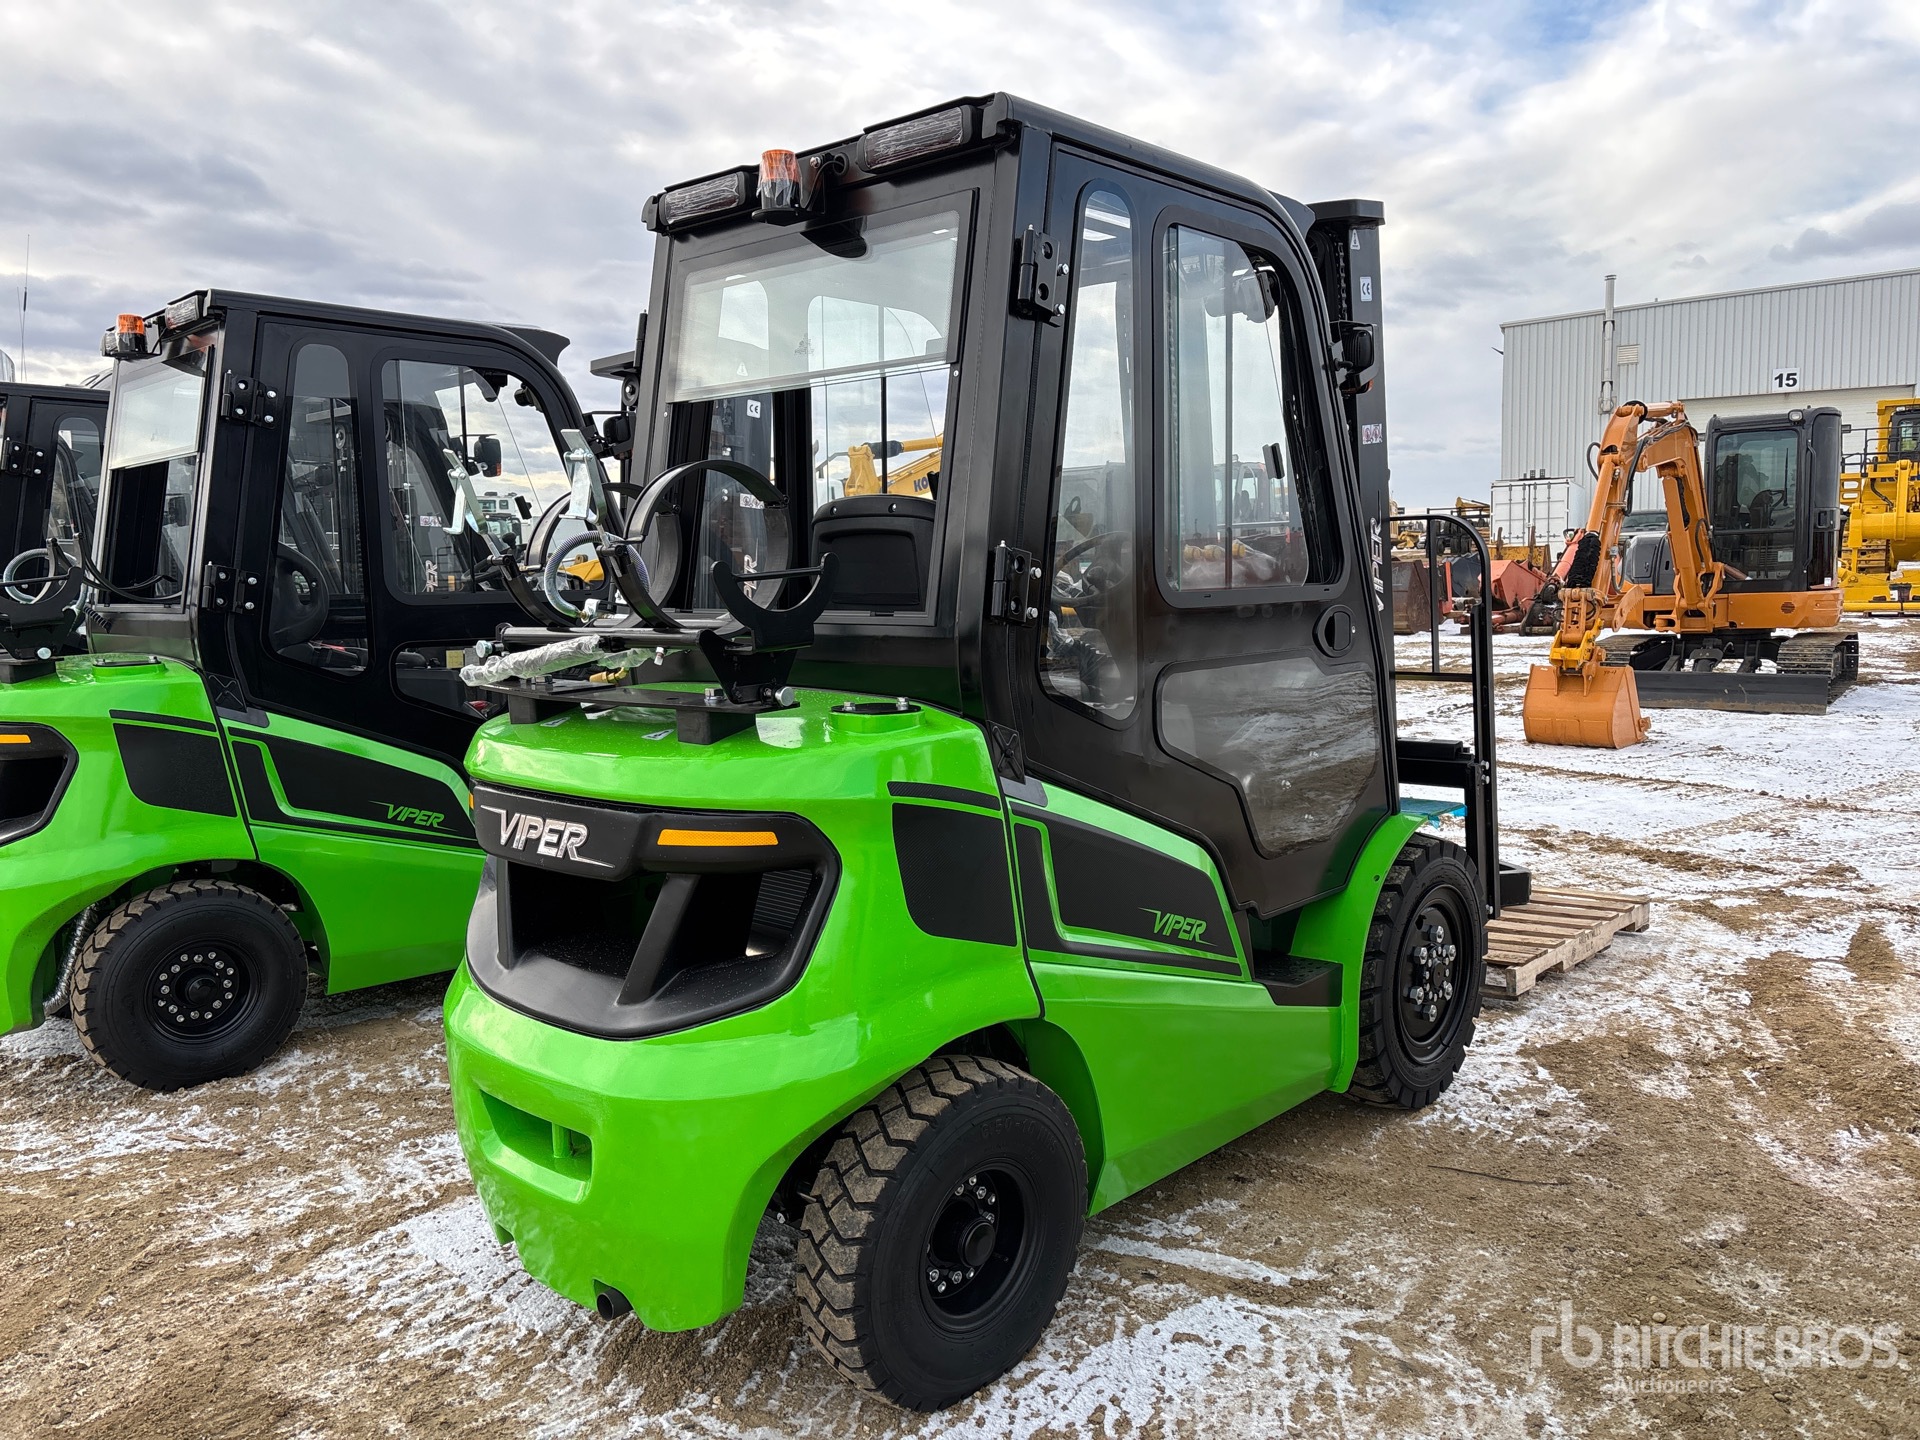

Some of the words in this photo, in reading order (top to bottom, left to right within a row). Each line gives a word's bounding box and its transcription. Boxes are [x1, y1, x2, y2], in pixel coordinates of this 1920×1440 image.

[1774, 372, 1798, 388] 15
[372, 801, 452, 830] VIPER
[486, 806, 607, 867] VIPER
[1142, 908, 1212, 944] VIPER
